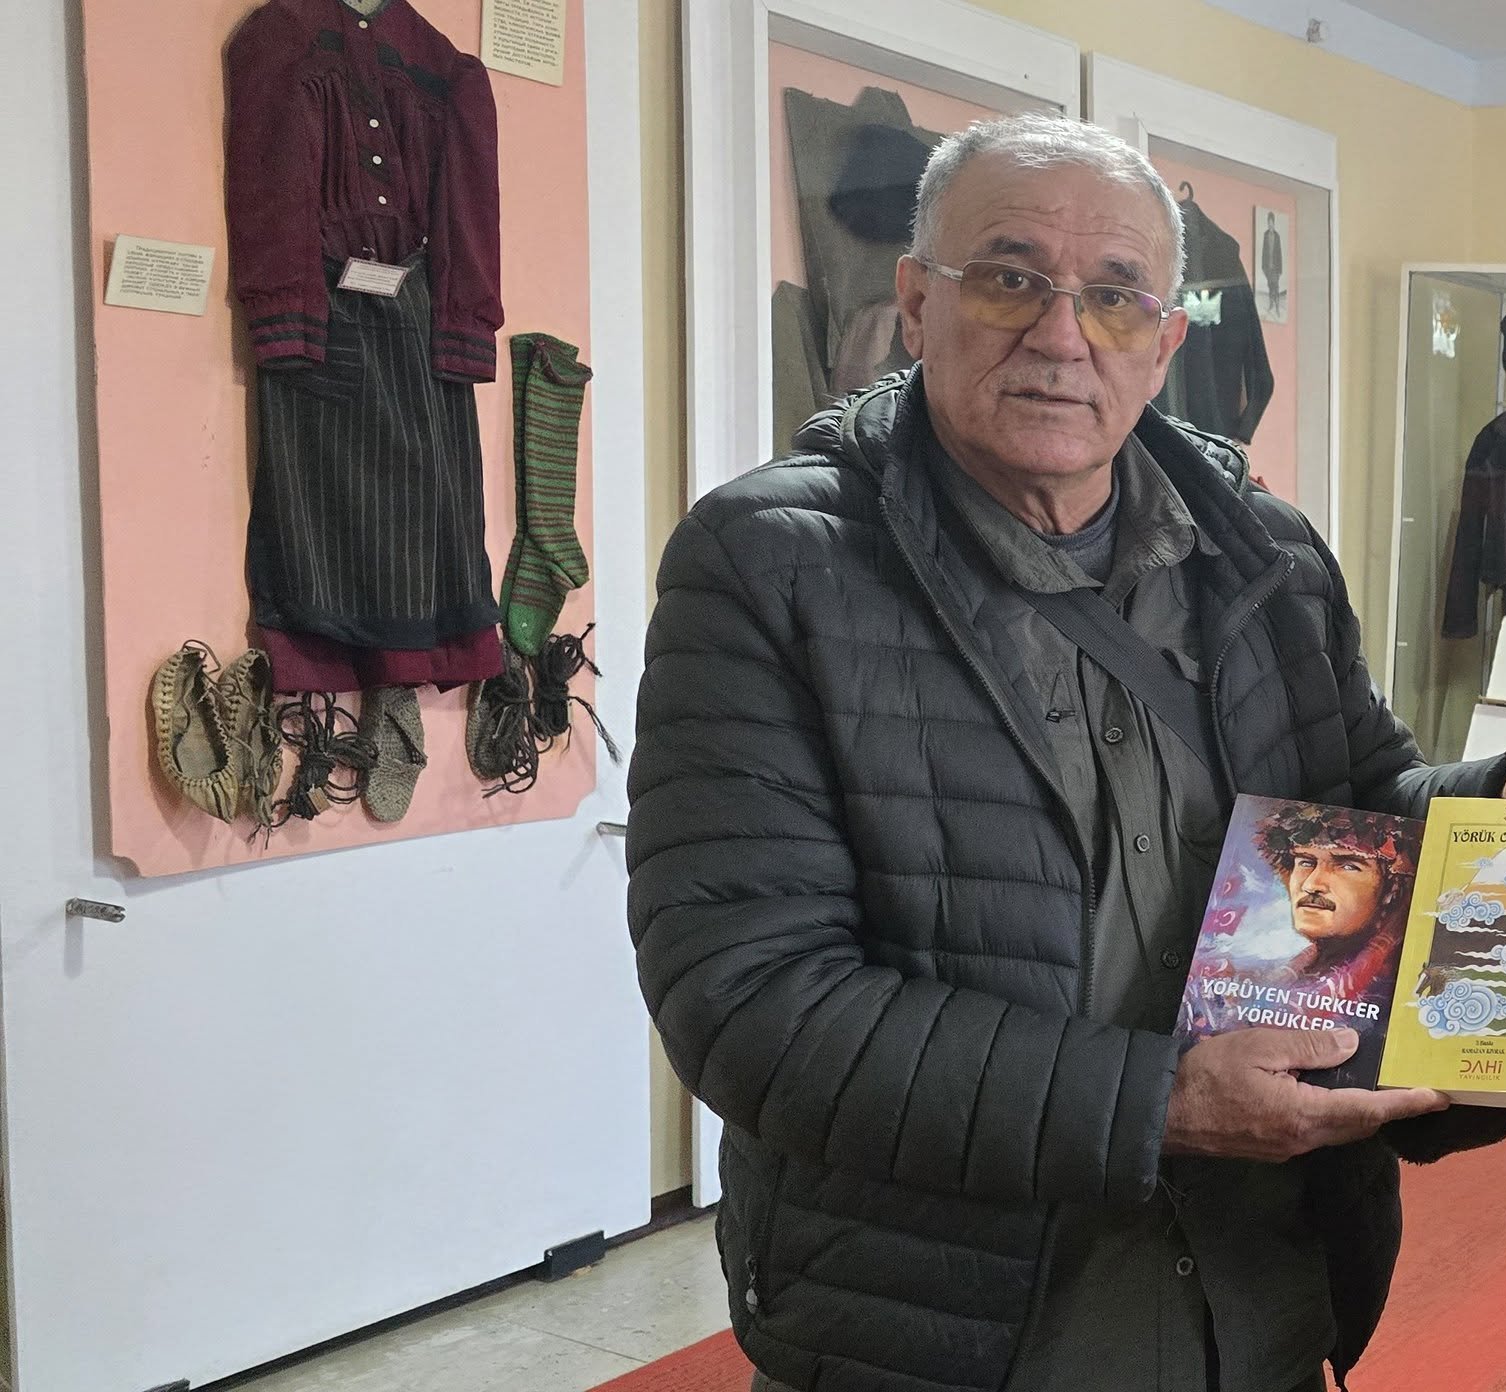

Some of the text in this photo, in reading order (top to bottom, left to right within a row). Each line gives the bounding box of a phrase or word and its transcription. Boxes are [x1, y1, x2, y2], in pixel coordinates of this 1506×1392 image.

[1453, 829, 1495, 843] YÖRÜK
[1236, 1003, 1335, 1030] YÖRÜKLER
[1296, 989, 1381, 1021] TÜRKLER
